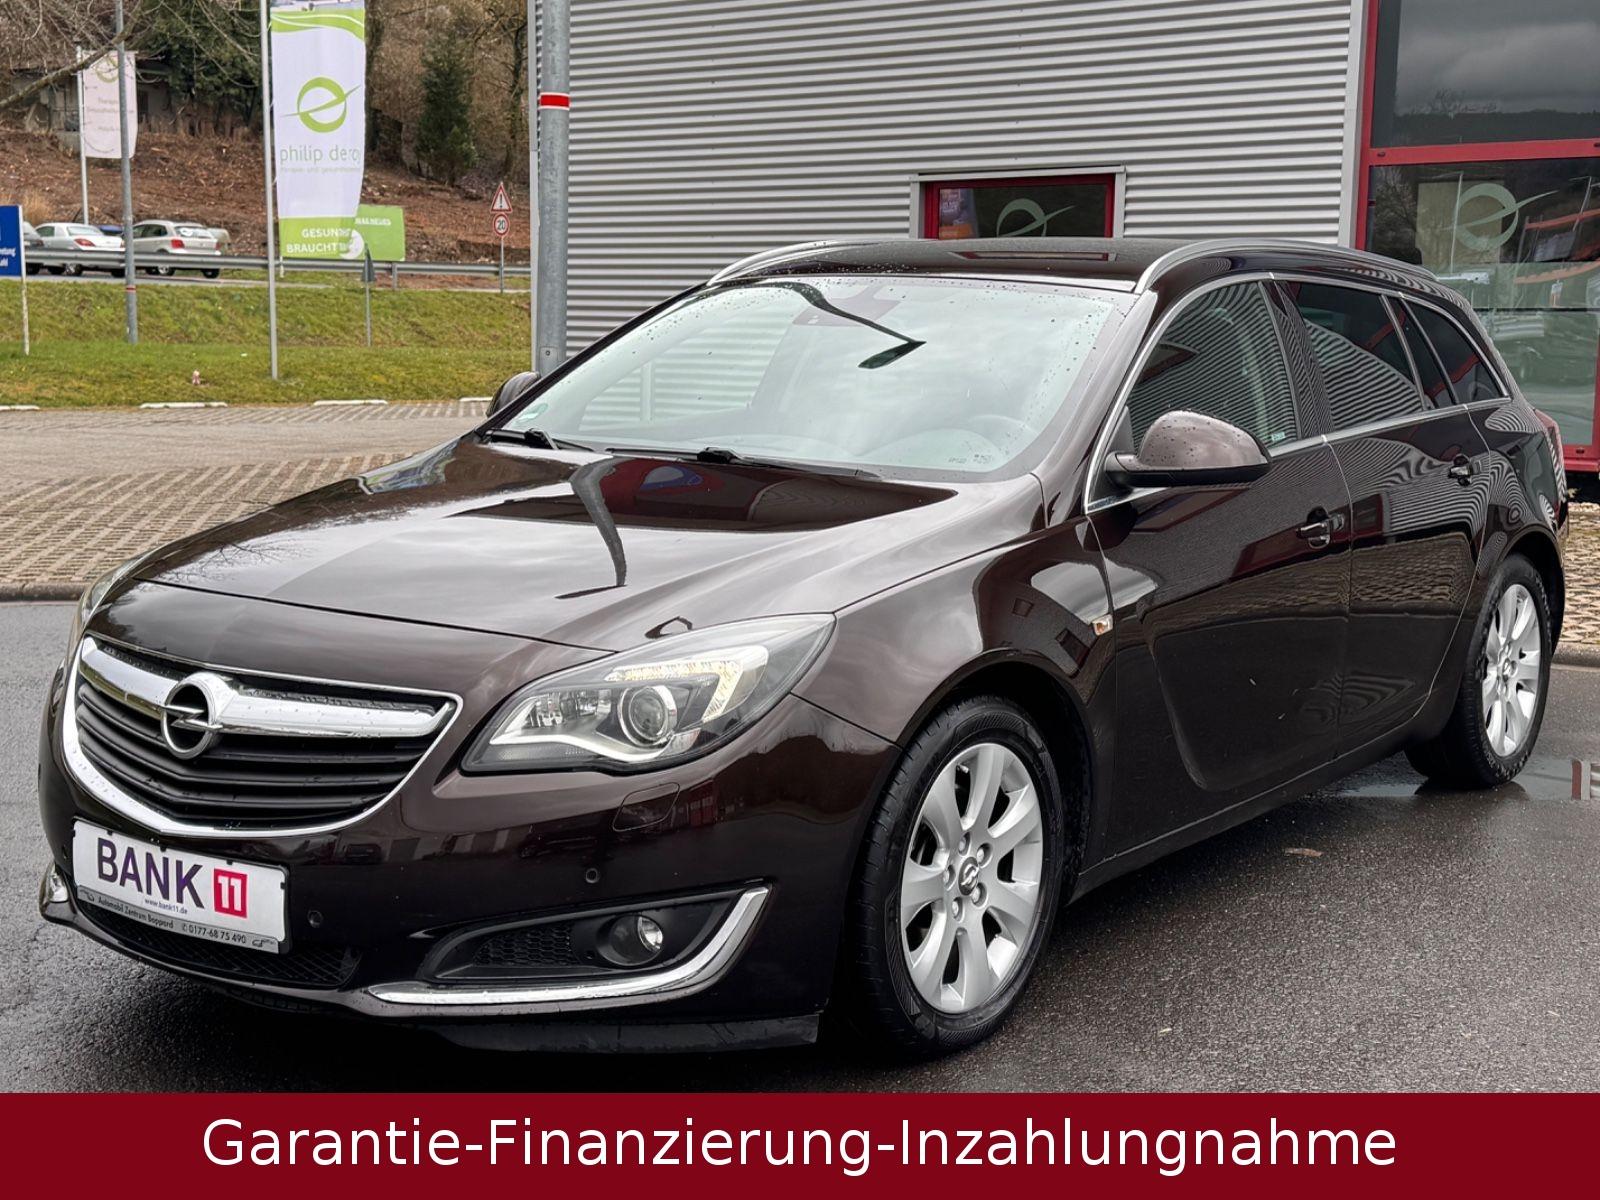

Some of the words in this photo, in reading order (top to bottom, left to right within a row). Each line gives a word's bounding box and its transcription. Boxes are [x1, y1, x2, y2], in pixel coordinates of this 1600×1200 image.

[279, 144, 323, 165] philip
[497, 219, 506, 231] 20
[97, 837, 205, 909] BANK
[217, 875, 243, 912] 11
[144, 898, 188, 915] www.bank11.de
[98, 896, 124, 912] Automobil
[124, 905, 147, 921] Zentrum
[147, 911, 174, 929] Boppard
[188, 923, 219, 940] 0177-68
[220, 930, 230, 942] 75
[231, 931, 247, 944] 490
